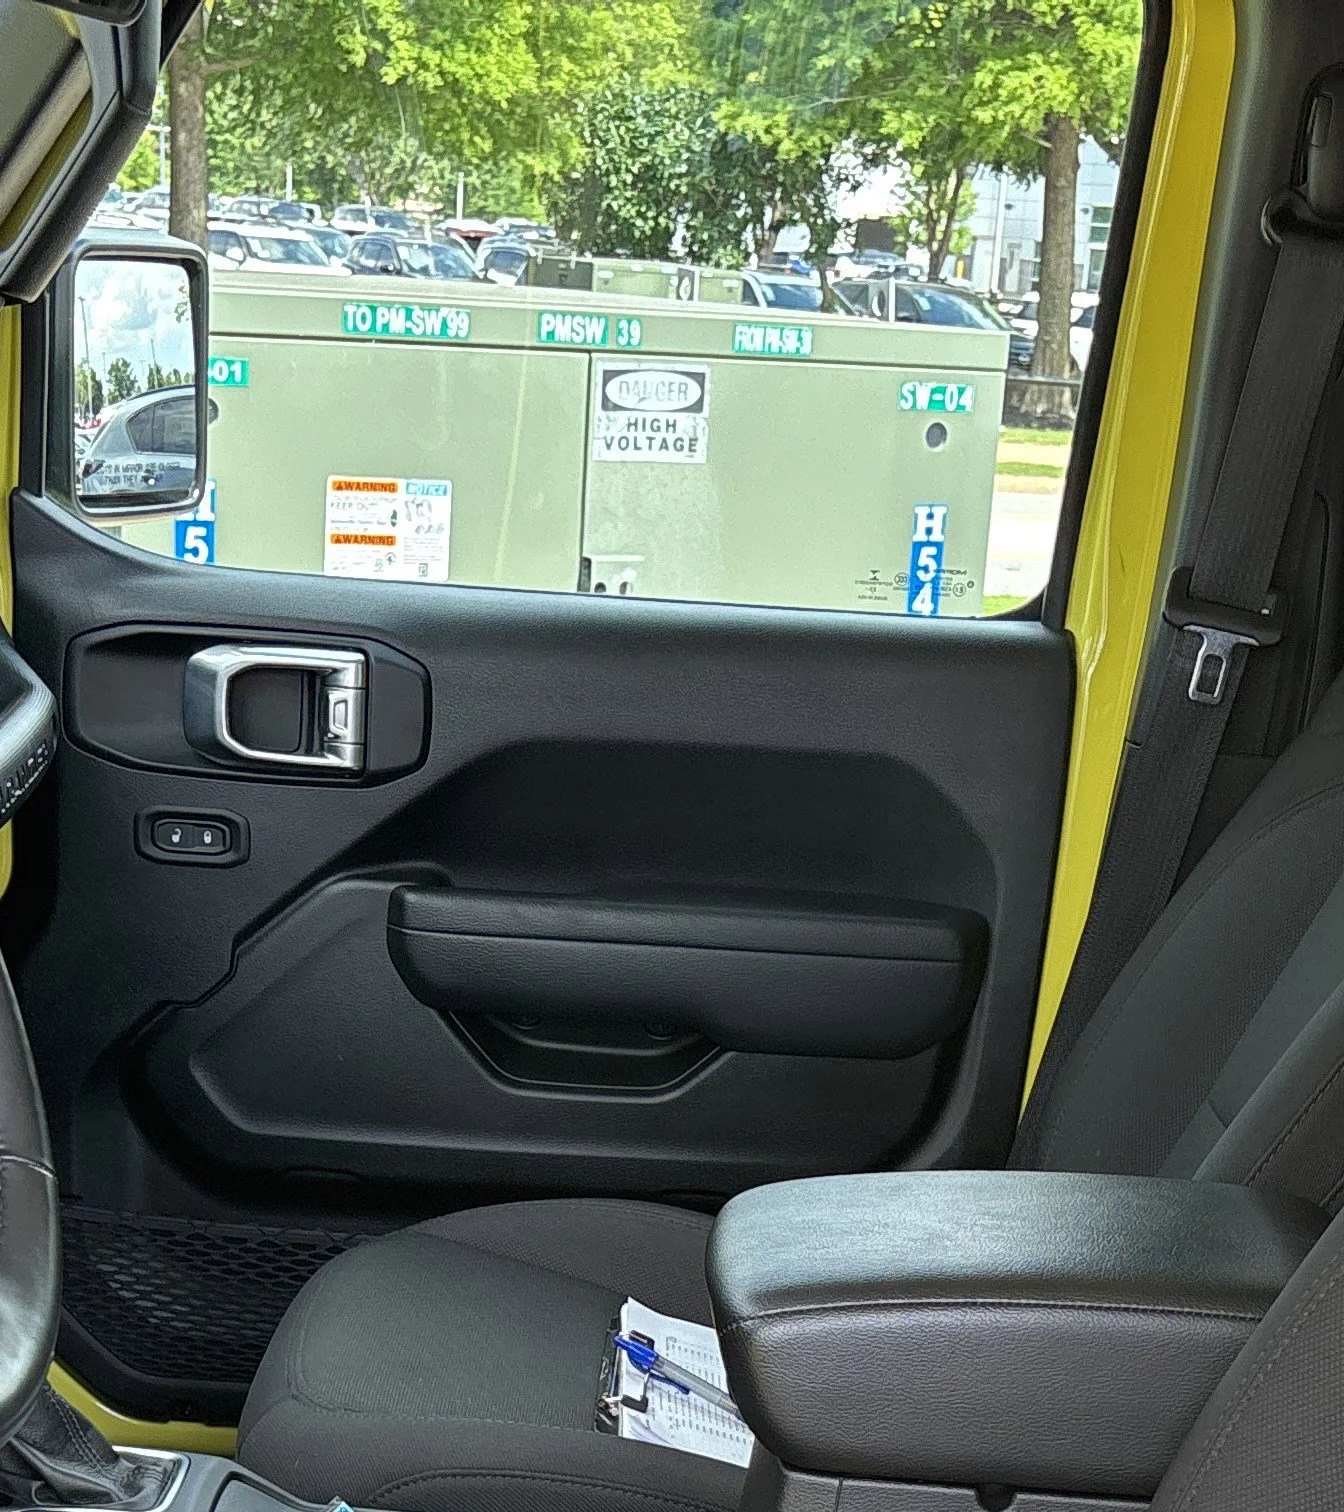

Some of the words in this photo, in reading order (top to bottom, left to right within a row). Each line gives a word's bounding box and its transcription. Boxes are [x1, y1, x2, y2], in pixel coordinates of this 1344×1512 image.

[344, 304, 372, 332] TO
[541, 313, 606, 344] PMSW
[617, 319, 641, 346] 39
[618, 379, 689, 402] DANGER
[899, 381, 974, 412] SW-04
[626, 416, 677, 434] HIGH
[604, 435, 699, 453] VOLTAGE
